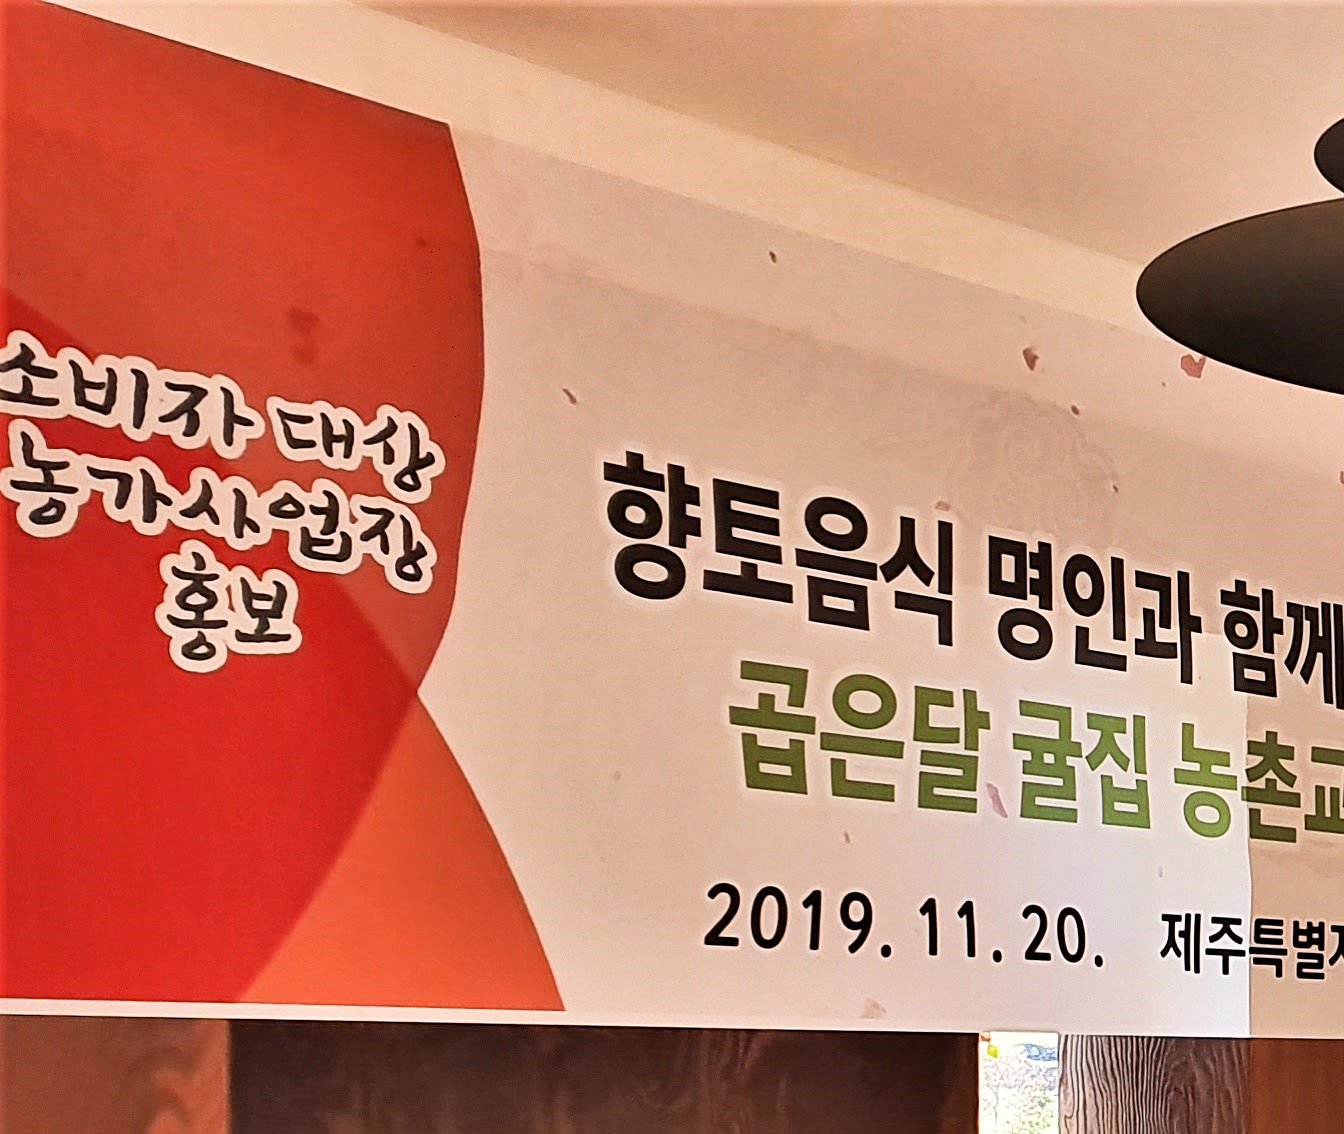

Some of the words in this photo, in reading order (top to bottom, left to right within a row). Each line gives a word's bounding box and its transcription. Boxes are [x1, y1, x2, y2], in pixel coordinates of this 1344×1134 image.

[0, 343, 255, 447] 소비자
[276, 408, 437, 492] 대상
[10, 430, 428, 583] 농가사업장
[603, 450, 955, 647] 향토음식
[987, 534, 1202, 685] 명인과
[167, 551, 292, 661] 홍보
[728, 659, 991, 814] 곱은달
[1012, 698, 1151, 829] 귤집
[703, 881, 893, 959] 2019.
[918, 896, 1003, 964] 11.
[1020, 903, 1105, 968] 20.
